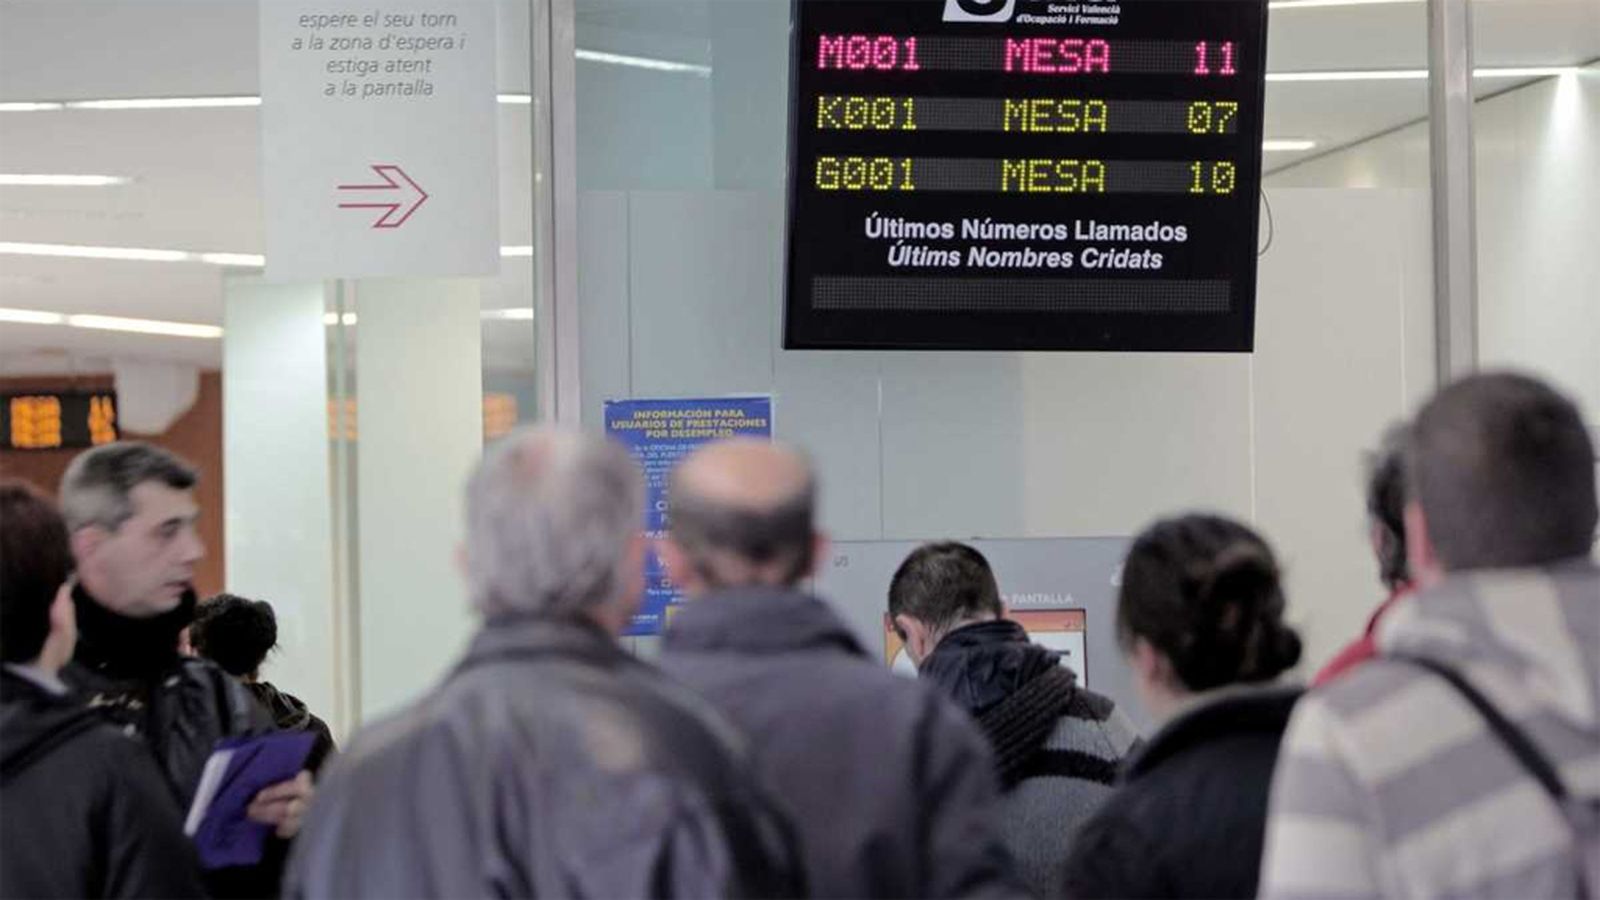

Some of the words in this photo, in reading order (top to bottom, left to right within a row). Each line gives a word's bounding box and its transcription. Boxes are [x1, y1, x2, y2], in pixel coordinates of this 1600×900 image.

[1047, 4, 1079, 13] Servici
[1082, 4, 1121, 14] Valencià
[299, 13, 358, 31] espere
[363, 10, 379, 27] el
[383, 14, 414, 27] seu
[421, 11, 457, 27] torn
[1075, 14, 1119, 25] Formació
[291, 37, 303, 50] a
[308, 34, 324, 50] la
[330, 37, 372, 50] zona
[378, 34, 454, 53] d'espera
[818, 35, 920, 71] M001
[1005, 38, 1111, 74] MESA
[1194, 41, 1237, 75] 11
[326, 57, 379, 77] estiga
[384, 58, 433, 73] atent
[324, 83, 336, 97] a
[342, 80, 357, 97] la
[363, 80, 434, 99] pantalla
[816, 96, 918, 131] K001
[1003, 98, 1108, 133] MESA
[1187, 101, 1239, 134] 07
[815, 156, 916, 191] G001
[1001, 158, 1106, 193] MESA
[1189, 160, 1237, 194] 10
[864, 211, 954, 239] Últimos
[961, 217, 1068, 240] Números
[1074, 219, 1188, 242] Llamados
[887, 240, 961, 267] Últims
[967, 246, 1073, 268] Nombres
[1080, 247, 1163, 269] Cridats
[611, 420, 667, 429] USUARIOS
[669, 419, 684, 428] DE
[686, 418, 767, 429] PRESTACIONES
[633, 409, 712, 419] INFORMACIÓN
[714, 409, 744, 418] PARA
[646, 429, 669, 439] POR
[671, 428, 733, 439] DESEMPLEO
[1012, 592, 1074, 604] PANTALLA
